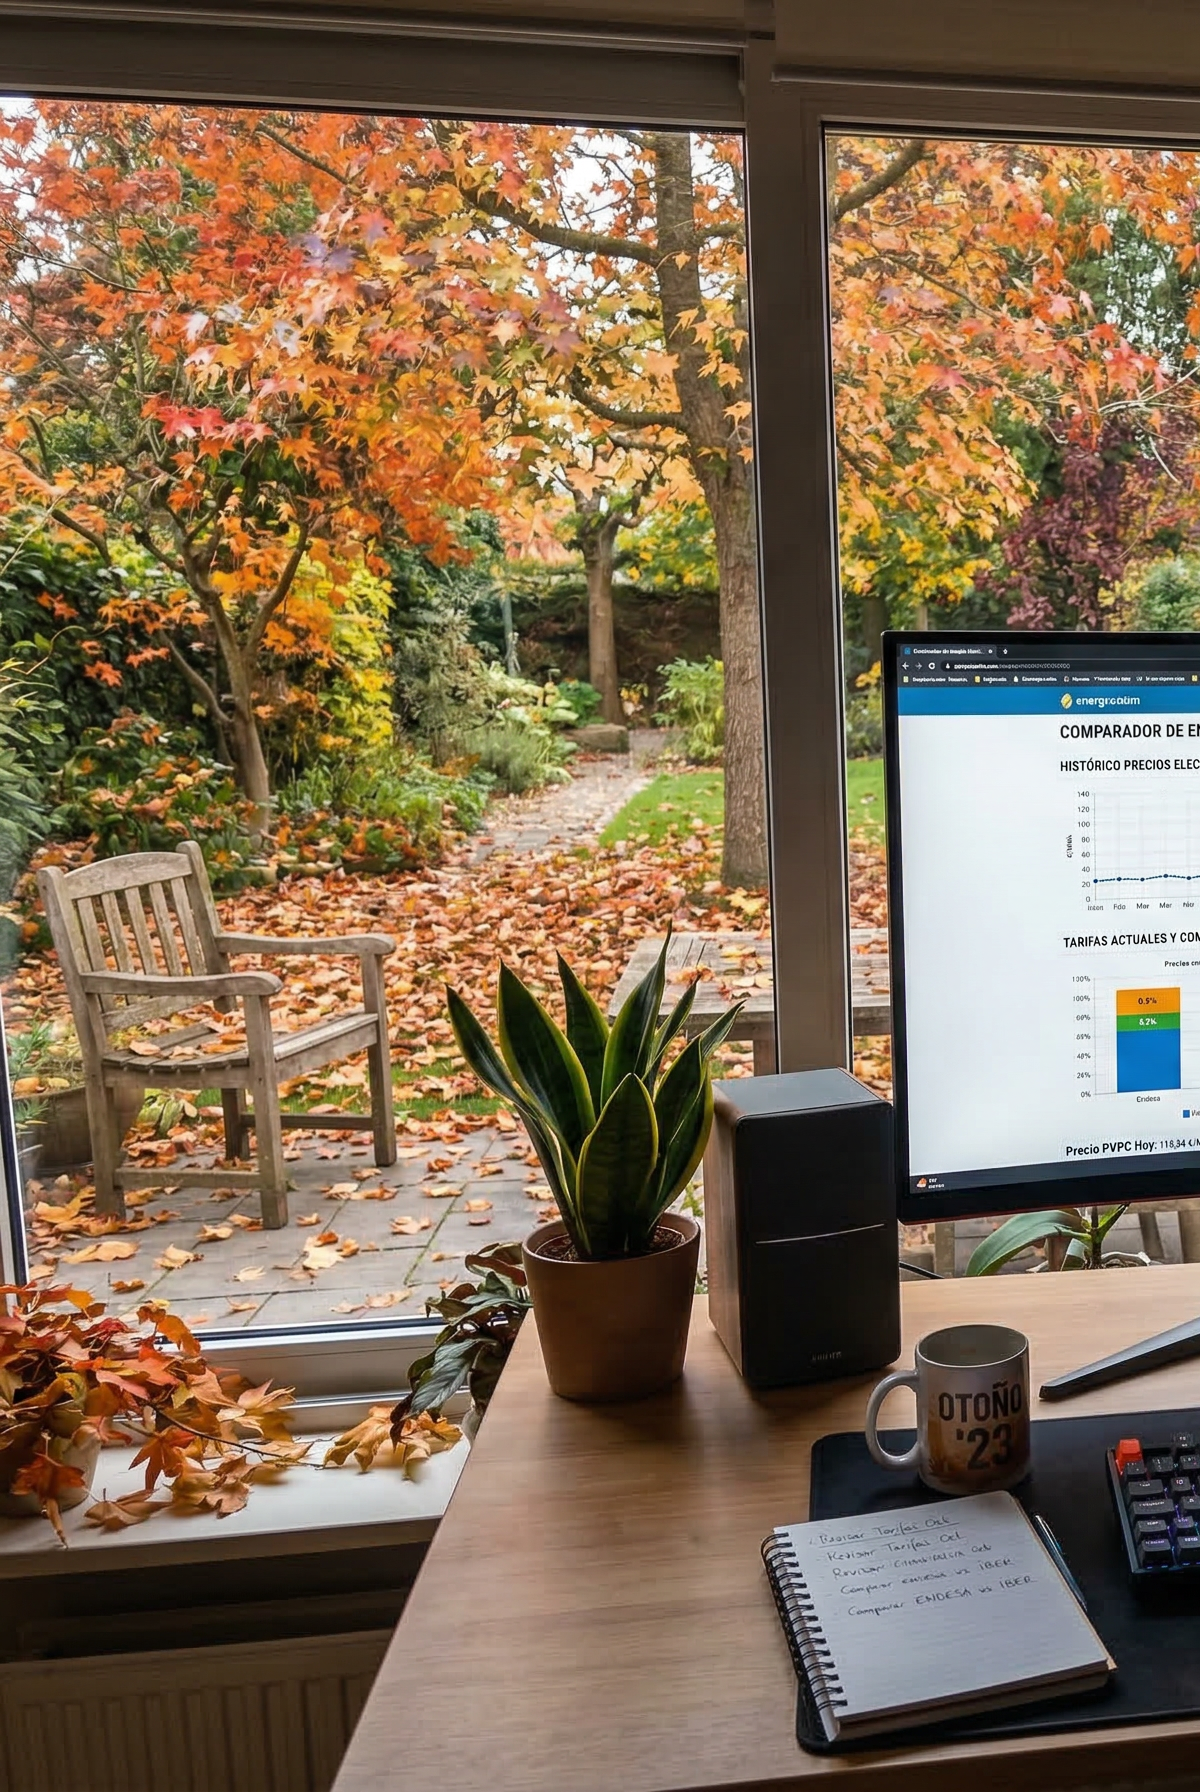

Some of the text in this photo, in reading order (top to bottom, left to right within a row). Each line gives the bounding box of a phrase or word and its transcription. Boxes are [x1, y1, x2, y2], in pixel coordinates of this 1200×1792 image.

[1060, 724, 1162, 739] COMPARADOR
[1166, 724, 1184, 738] DE
[1060, 757, 1121, 772] HISTÓRICO
[1124, 758, 1171, 771] PRECIOS
[1063, 935, 1108, 948] TARIFAS
[1110, 933, 1167, 946] ACTUALES
[1170, 932, 1177, 944] Y
[1066, 1145, 1100, 1157] Precio
[1103, 1141, 1132, 1153] PVPC
[1134, 1139, 1157, 1152] Hoy:
[939, 1380, 1022, 1423] OTOÑO
[915, 1587, 972, 1605] ENDESA
